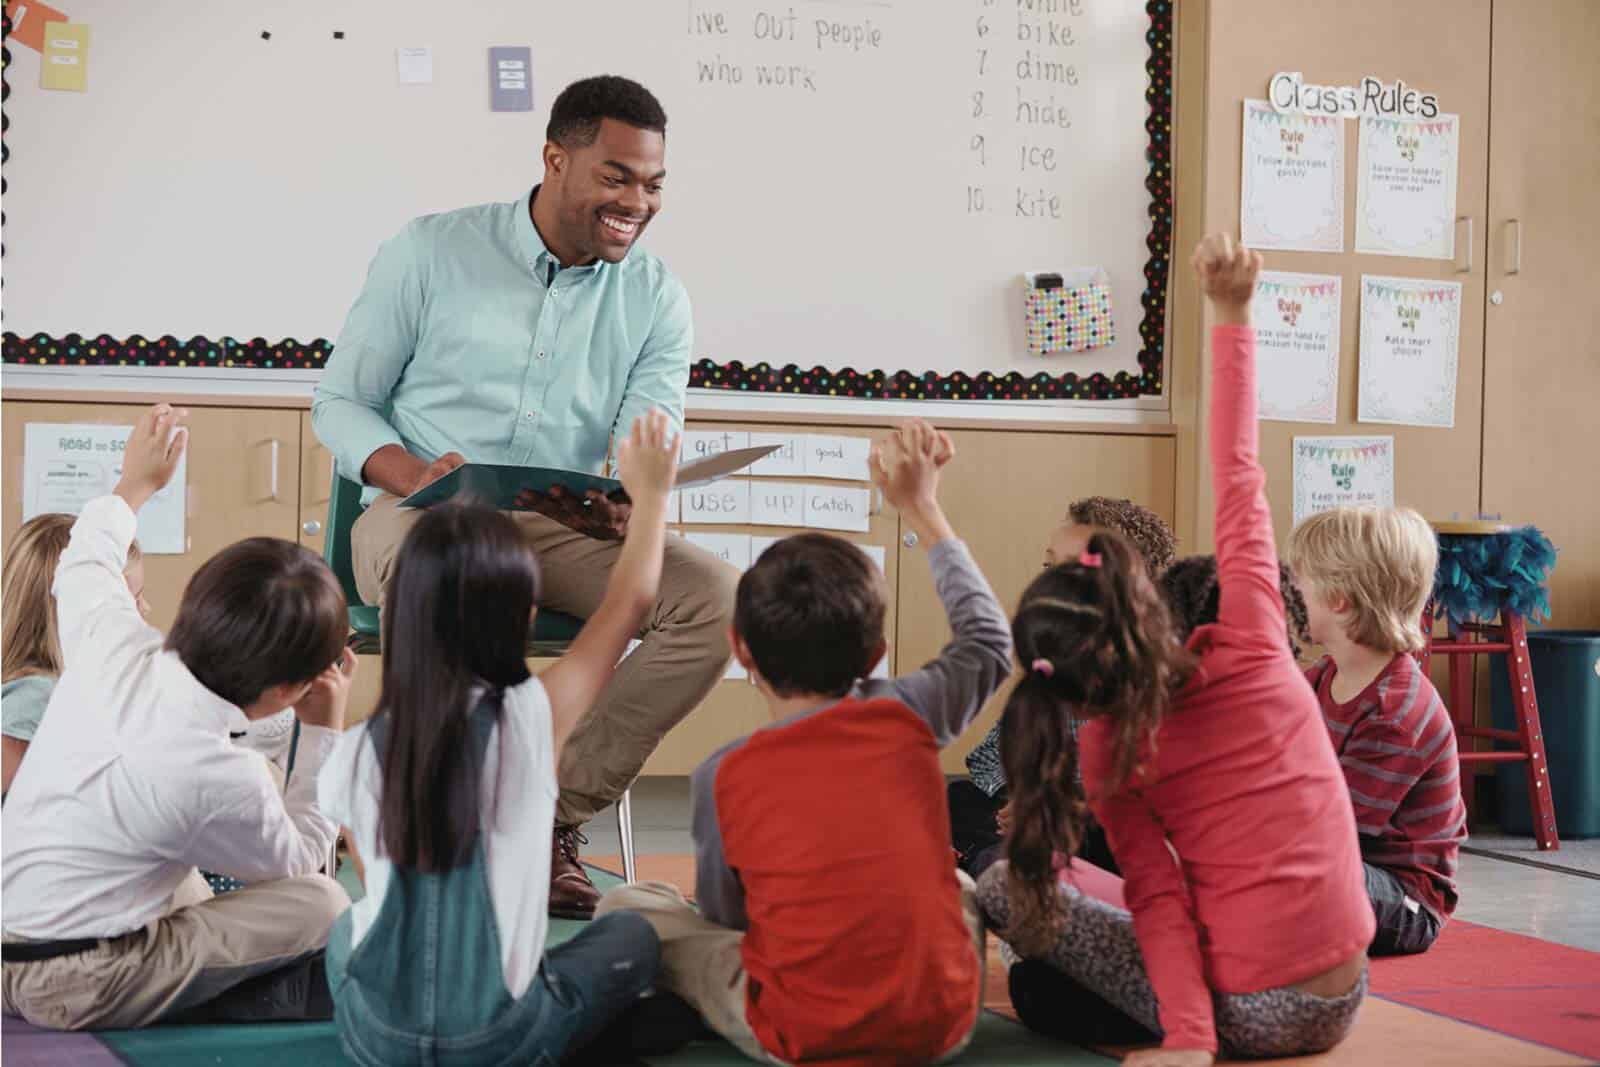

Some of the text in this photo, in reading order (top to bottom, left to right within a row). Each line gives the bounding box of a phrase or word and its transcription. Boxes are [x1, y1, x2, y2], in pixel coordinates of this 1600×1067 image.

[815, 18, 881, 51] people
[1017, 12, 1076, 47] bike
[696, 55, 817, 92] who work
[1016, 49, 1079, 86] dime
[1015, 85, 1072, 129] hide
[1273, 75, 1438, 119] Class Rules
[1280, 128, 1304, 144] Rule
[1396, 135, 1419, 149] Rule
[1015, 185, 1063, 219] kite
[1278, 298, 1302, 315] Rule
[1397, 305, 1420, 320] Rule
[815, 441, 844, 462] good
[1331, 463, 1355, 478] Rule
[690, 493, 737, 513] use
